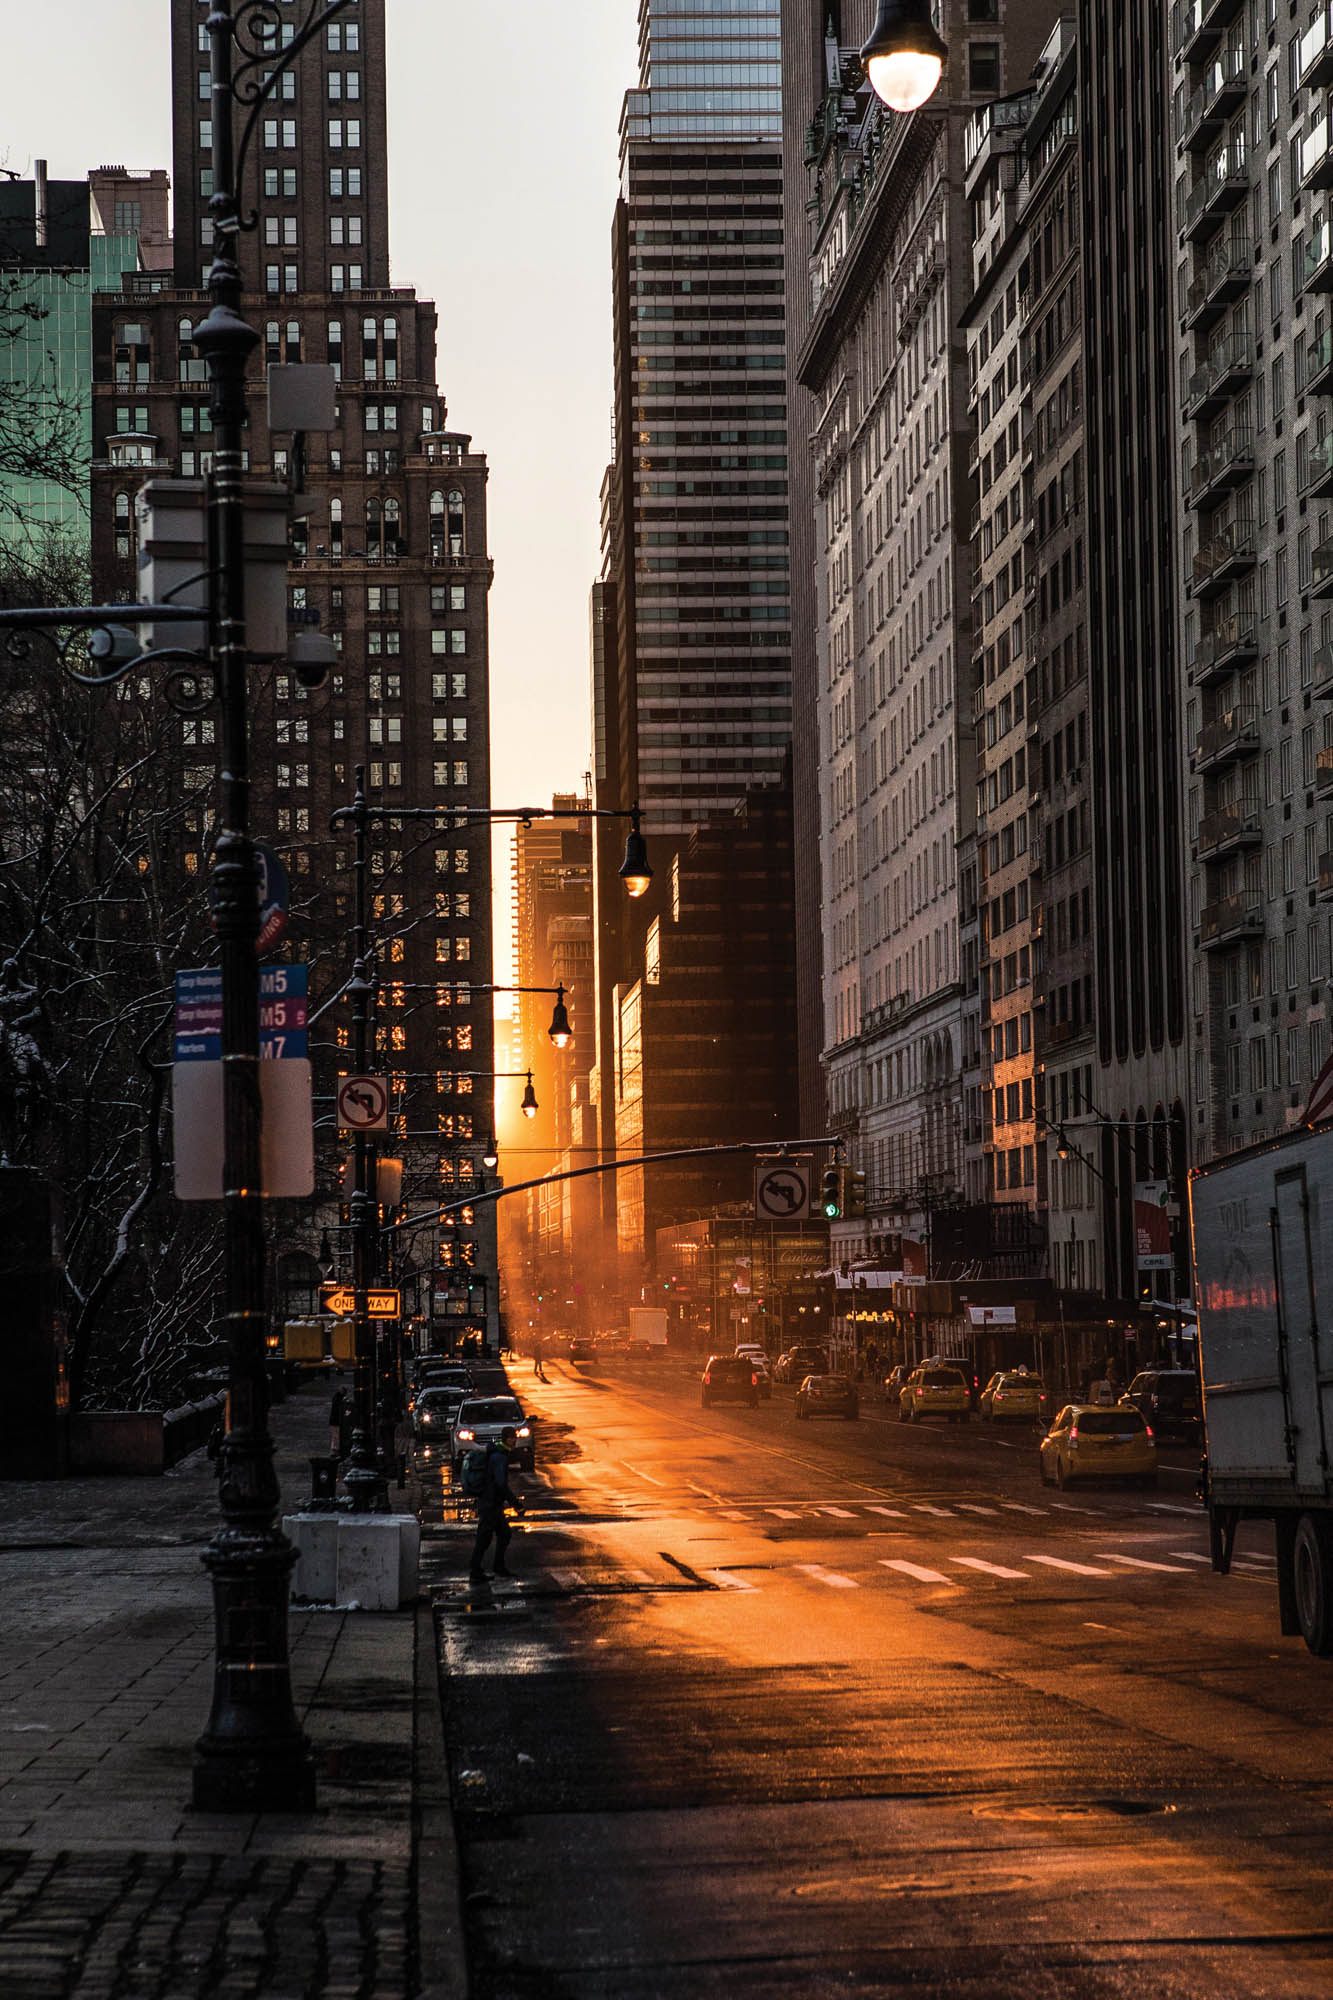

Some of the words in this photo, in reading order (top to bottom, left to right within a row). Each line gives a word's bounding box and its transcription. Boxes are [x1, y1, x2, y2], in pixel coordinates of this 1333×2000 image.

[260, 970, 288, 993] M5
[260, 1002, 287, 1027] M5
[259, 1035, 287, 1059] M7
[1143, 1258, 1165, 1266] CBRE
[334, 1298, 356, 1309] ONE
[367, 1298, 390, 1309] WAY
